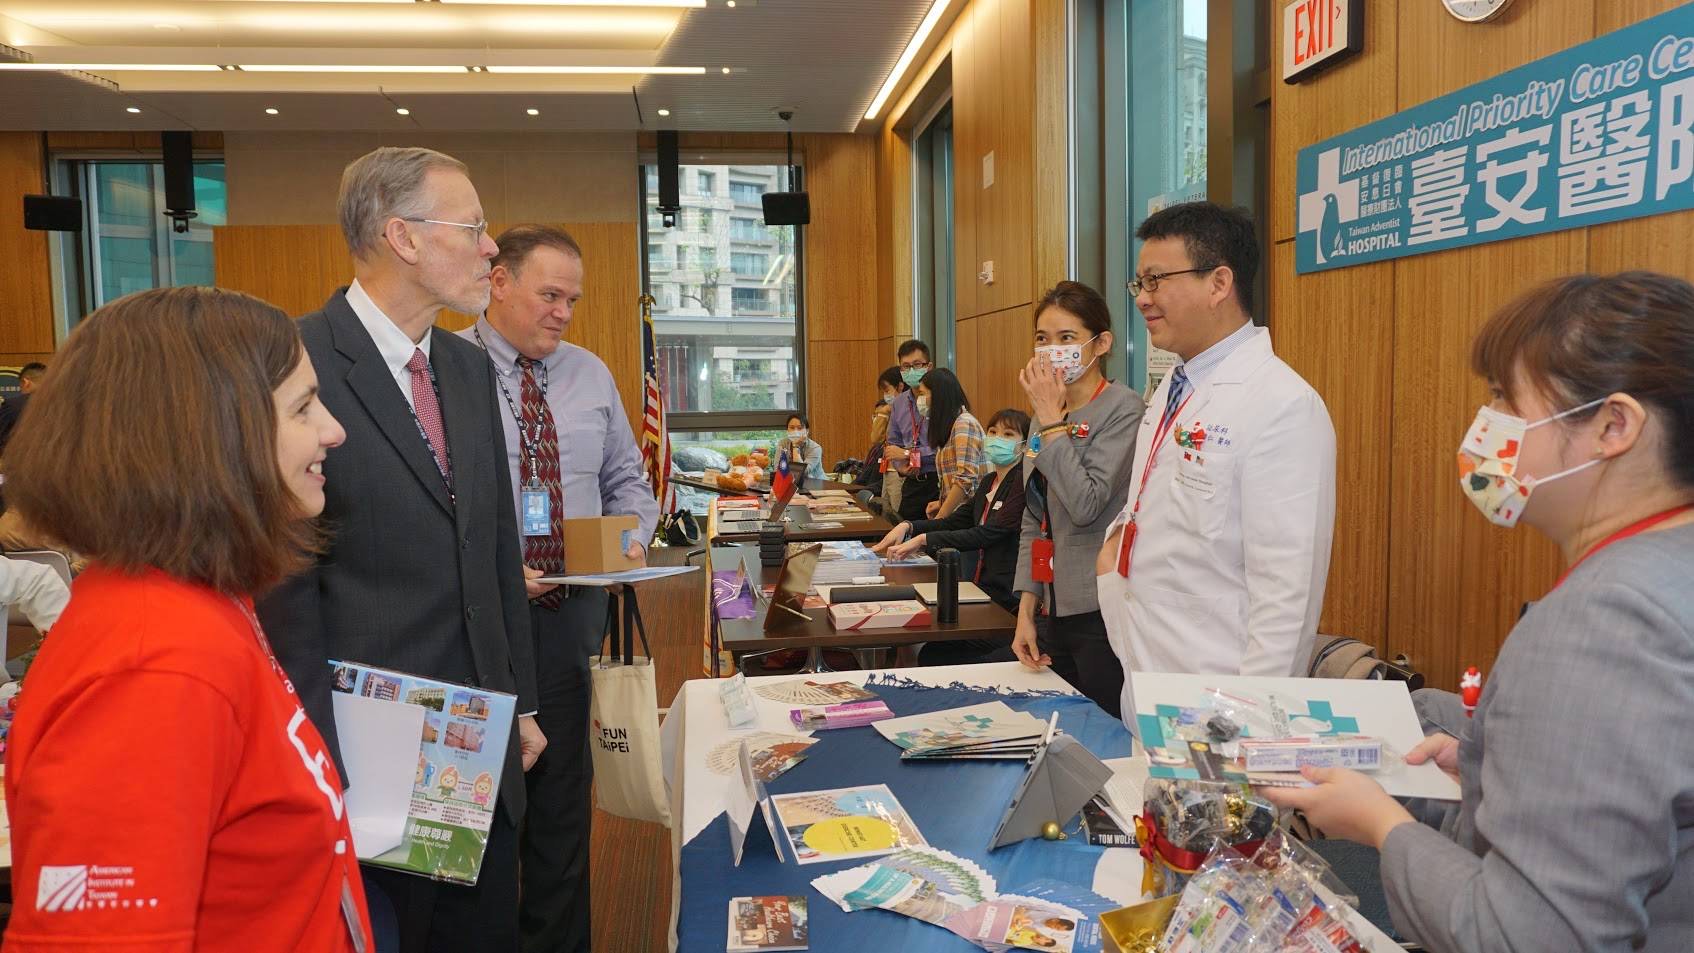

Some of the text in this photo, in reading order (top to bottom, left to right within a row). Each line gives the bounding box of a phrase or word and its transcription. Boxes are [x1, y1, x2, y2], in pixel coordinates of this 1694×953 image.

[1295, 0, 1334, 65] EXIT
[1342, 103, 1467, 175] International
[1466, 78, 1565, 137] Priority
[1570, 54, 1643, 103] Care
[1349, 218, 1400, 237] Taiwan Adventist
[1348, 232, 1401, 255] HOSPITAL
[602, 728, 627, 740] FUN
[1099, 834, 1136, 845] TOM WOLFE
